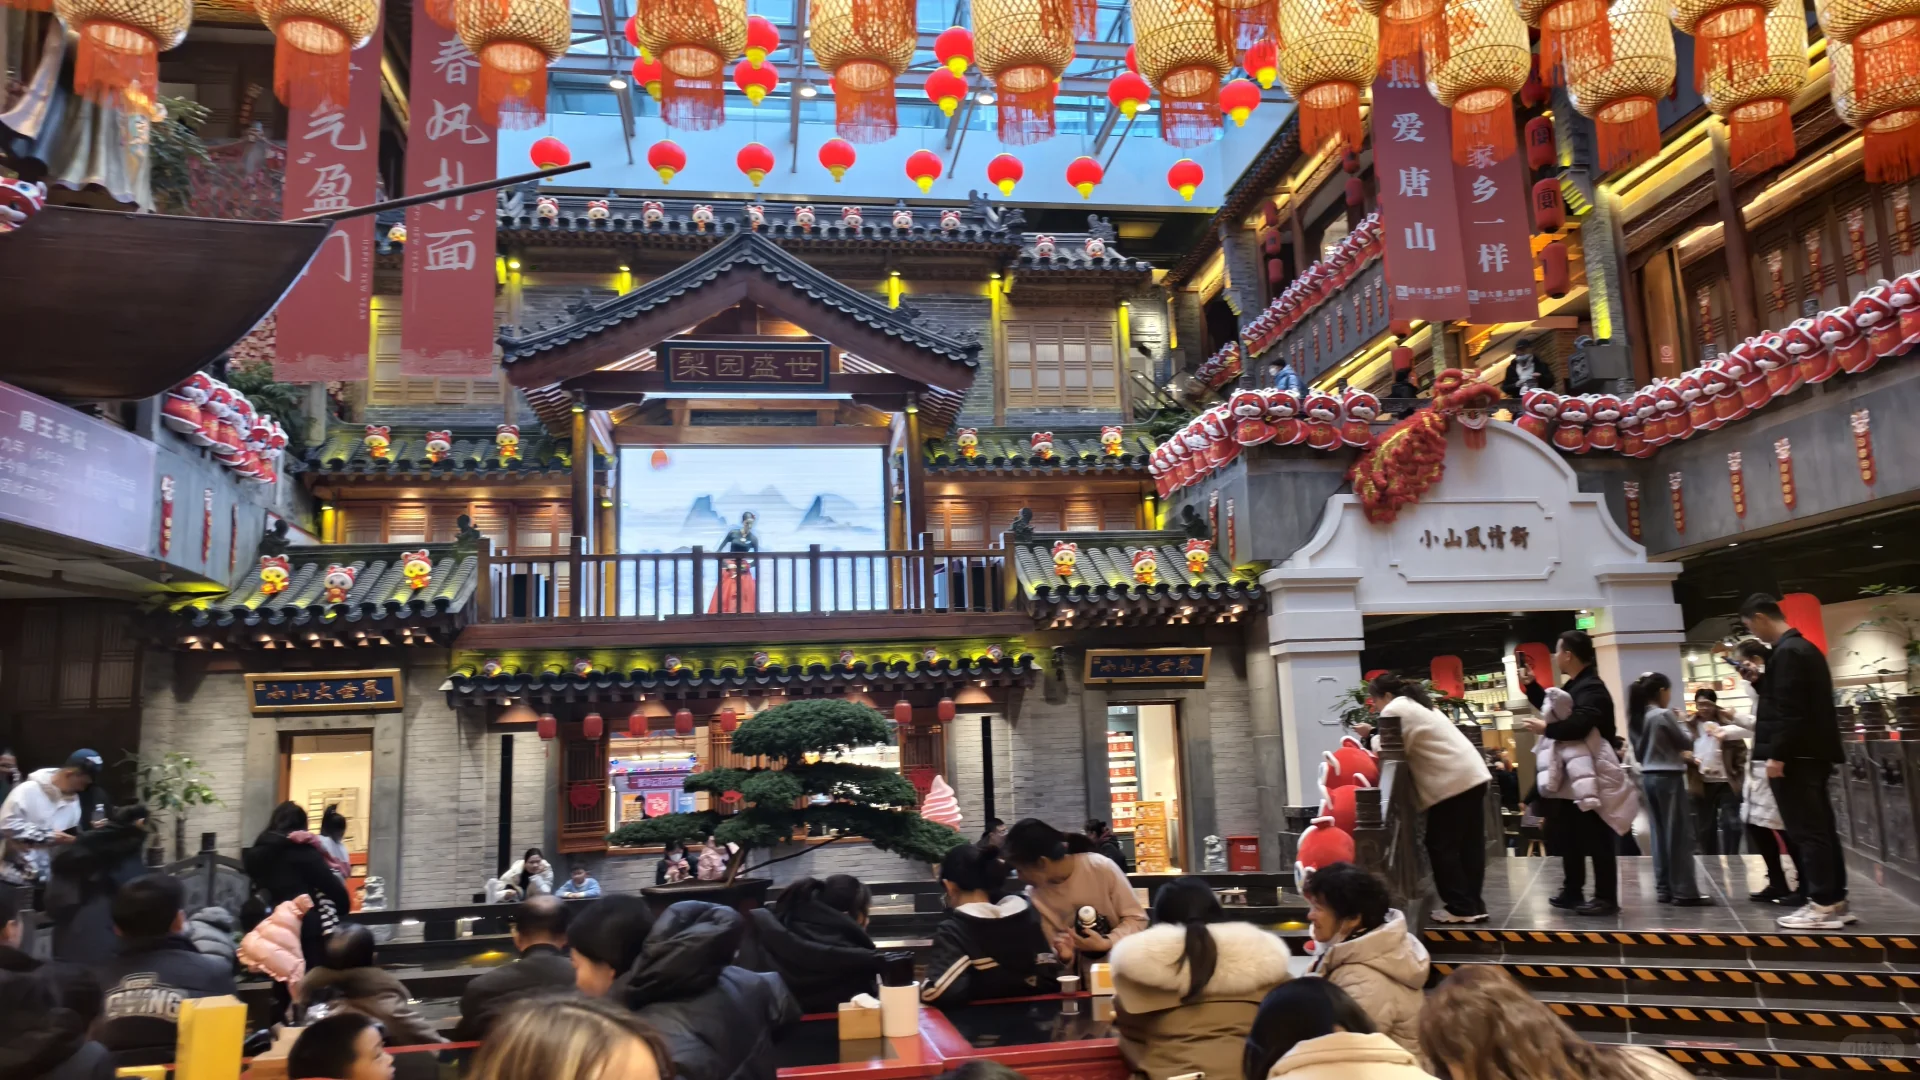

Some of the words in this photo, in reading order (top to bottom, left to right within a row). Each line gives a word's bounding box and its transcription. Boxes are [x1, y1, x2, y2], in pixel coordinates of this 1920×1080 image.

[297, 66, 368, 283] 气盈门
[424, 37, 490, 272] 春风扑面
[676, 351, 818, 380] 梨园盛世
